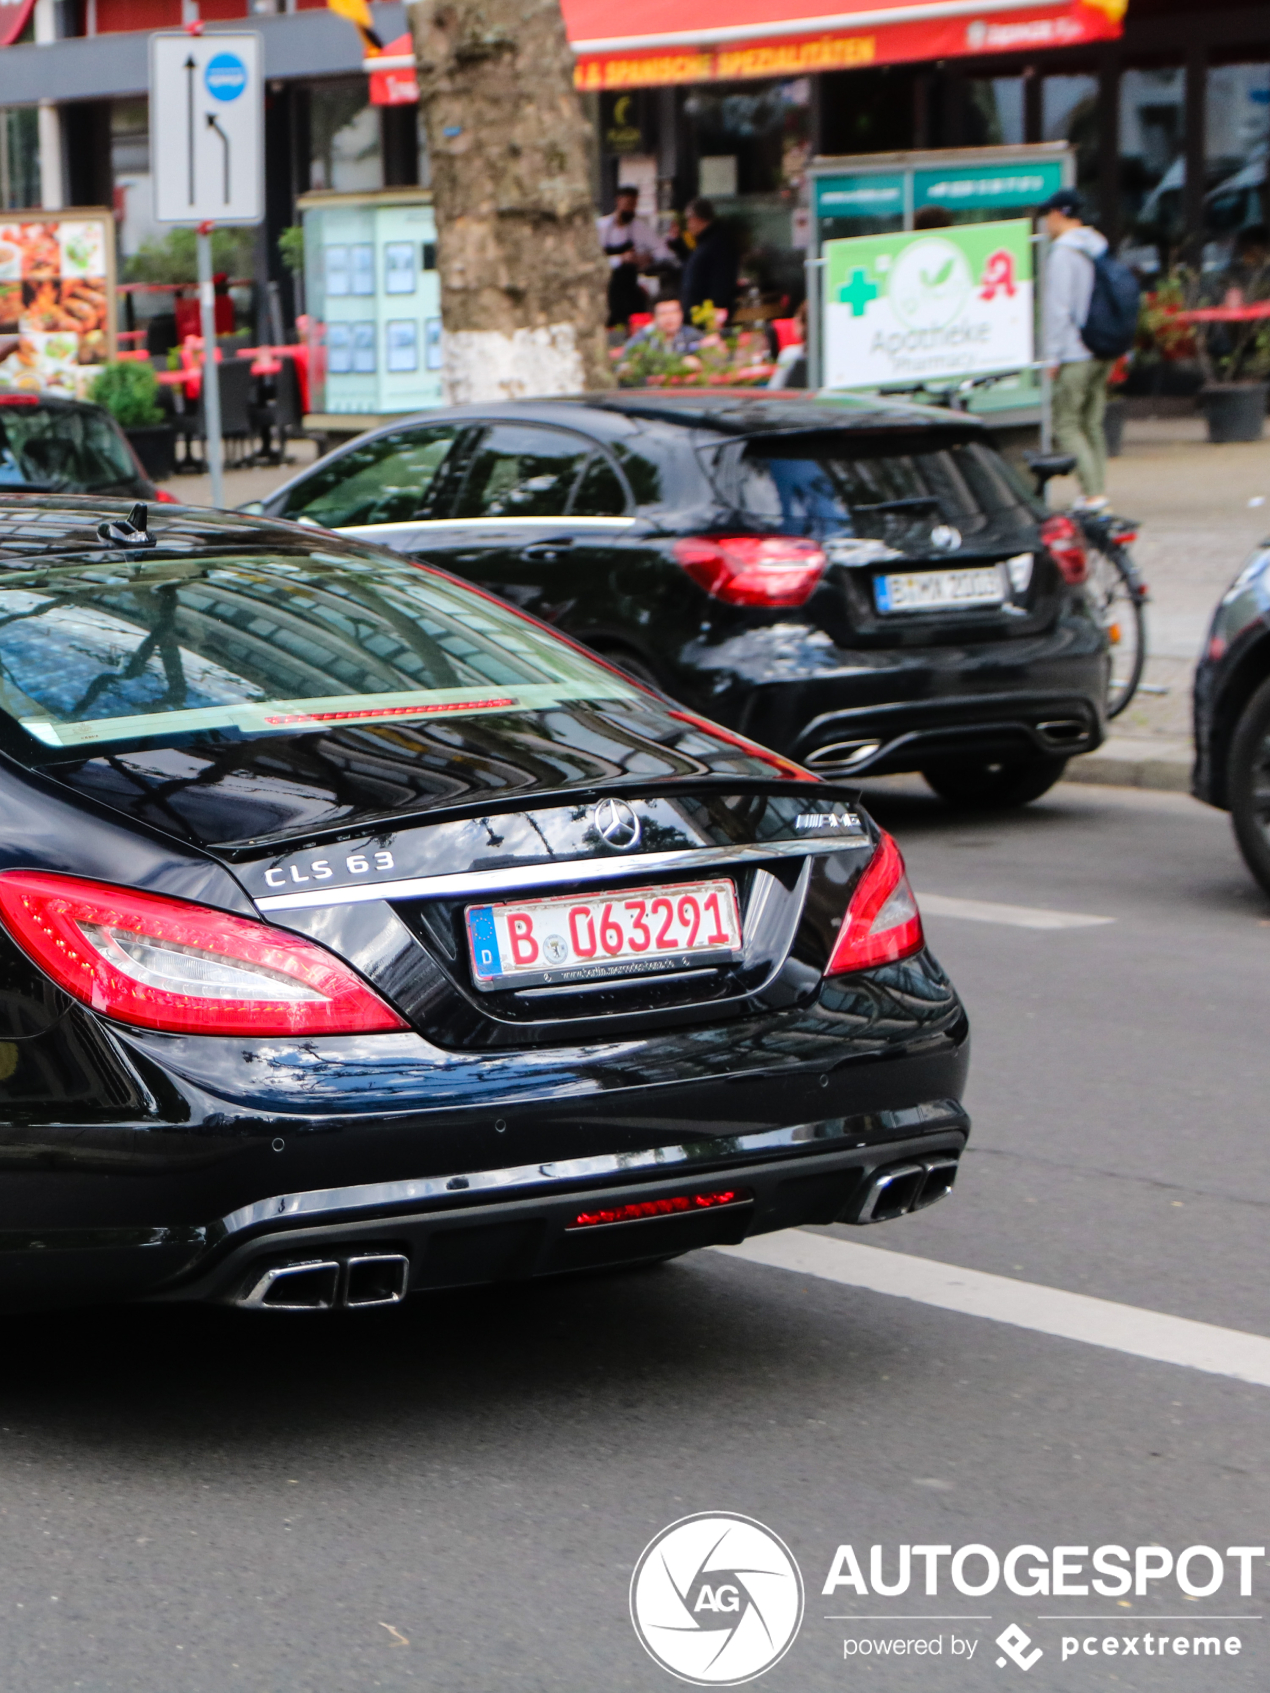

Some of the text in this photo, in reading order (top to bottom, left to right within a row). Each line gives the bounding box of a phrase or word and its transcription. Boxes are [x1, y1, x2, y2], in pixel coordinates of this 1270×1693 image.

[716, 35, 876, 78] SPEZIALITÄTEN
[870, 317, 991, 356] Apotheke
[814, 812, 862, 829] AMG
[264, 851, 394, 888] CLS 63
[505, 892, 730, 965] B 063291
[481, 949, 492, 964] D
